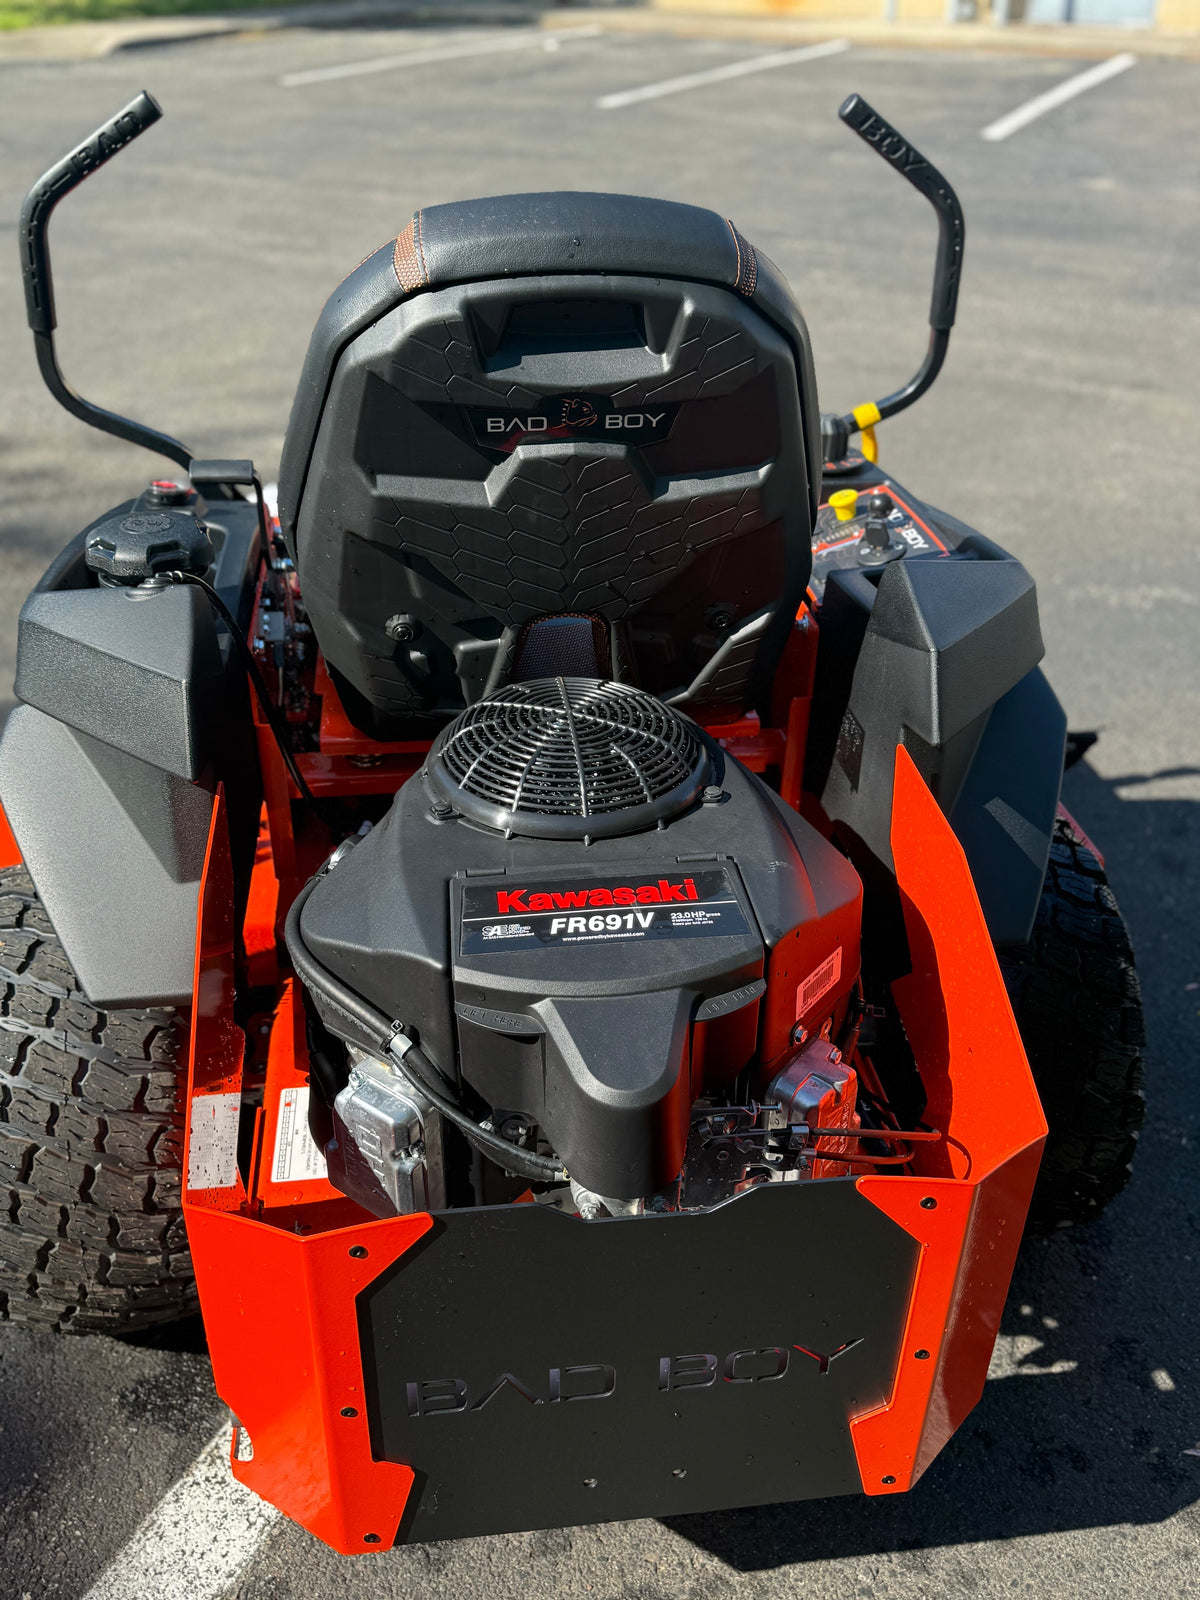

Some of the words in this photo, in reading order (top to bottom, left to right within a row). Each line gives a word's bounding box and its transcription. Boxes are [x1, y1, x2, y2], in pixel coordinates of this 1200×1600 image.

[71, 111, 143, 175] BAD
[859, 115, 927, 172] BOY
[487, 417, 547, 433] BAD
[605, 413, 666, 429] BOY
[901, 528, 929, 549] BOY
[496, 878, 699, 914] Kawasaki
[550, 911, 655, 935] FR691V
[691, 910, 706, 918] HP
[562, 931, 645, 942] www.poweredbykawasaki.com
[463, 1007, 488, 1020] LIFT
[494, 1014, 524, 1029] HERE
[406, 1365, 617, 1417] BAD
[658, 1337, 865, 1392] BOY
